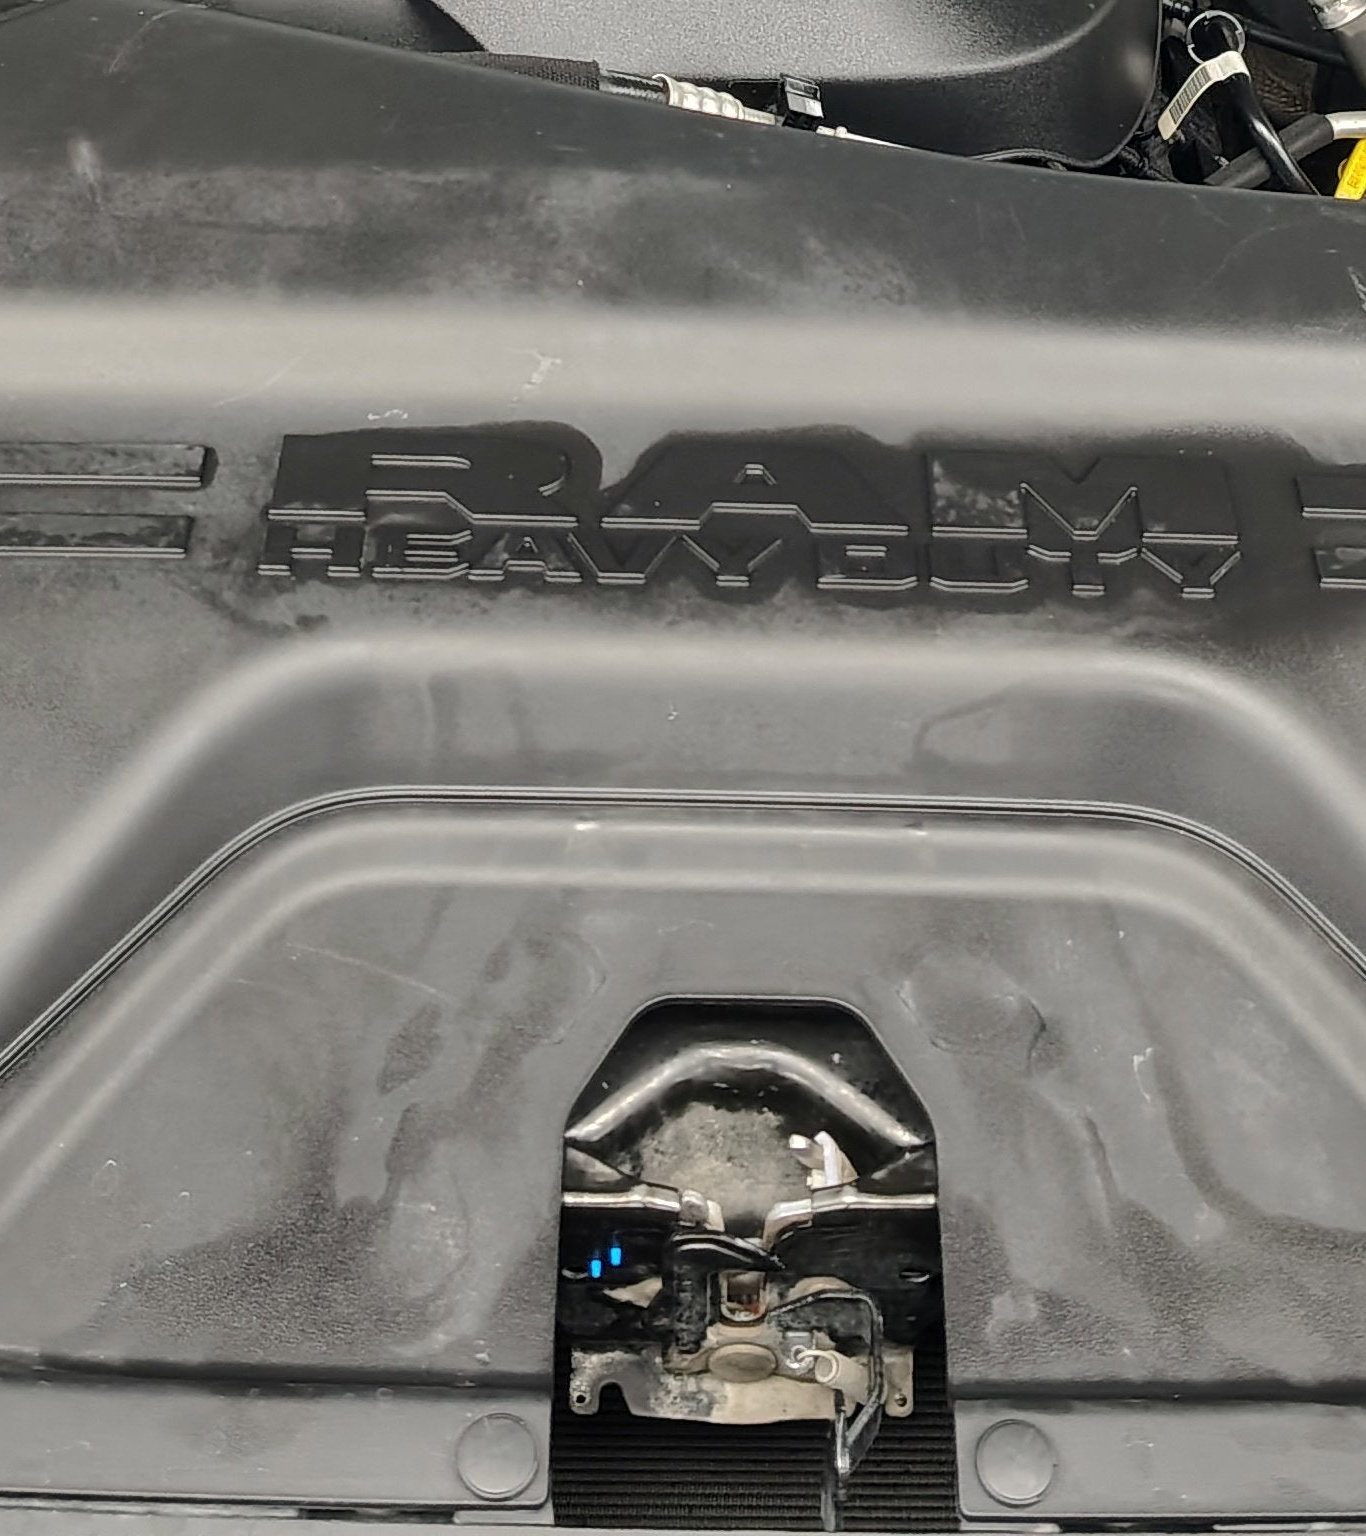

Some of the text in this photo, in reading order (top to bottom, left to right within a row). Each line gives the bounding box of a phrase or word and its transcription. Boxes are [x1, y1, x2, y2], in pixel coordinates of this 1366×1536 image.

[267, 432, 1239, 544] RAM
[257, 520, 1241, 600] HEAVY DUTY
